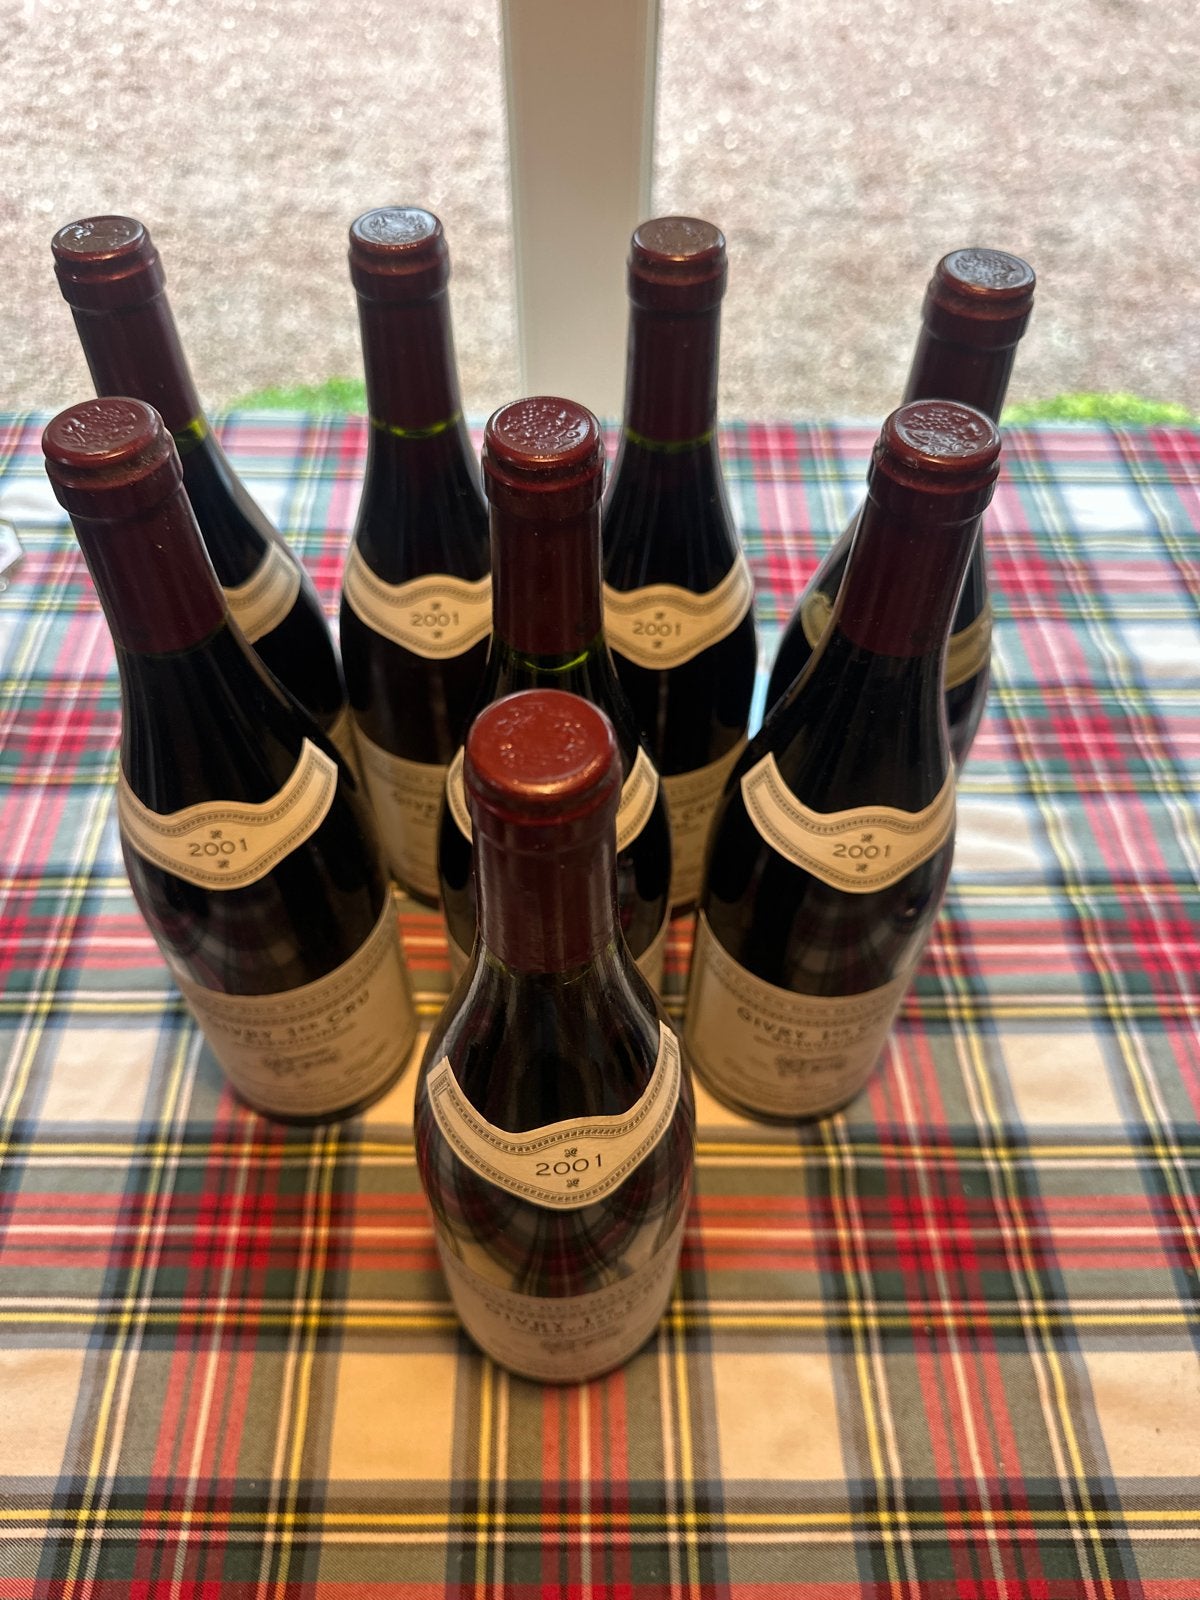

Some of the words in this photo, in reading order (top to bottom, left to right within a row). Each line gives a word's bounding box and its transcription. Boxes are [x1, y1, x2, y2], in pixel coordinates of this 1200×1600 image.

[410, 611, 460, 627] 2001
[632, 621, 682, 637] 2001
[188, 838, 248, 857] 2001
[832, 843, 891, 860] 2001
[535, 1153, 602, 1176] 2001
